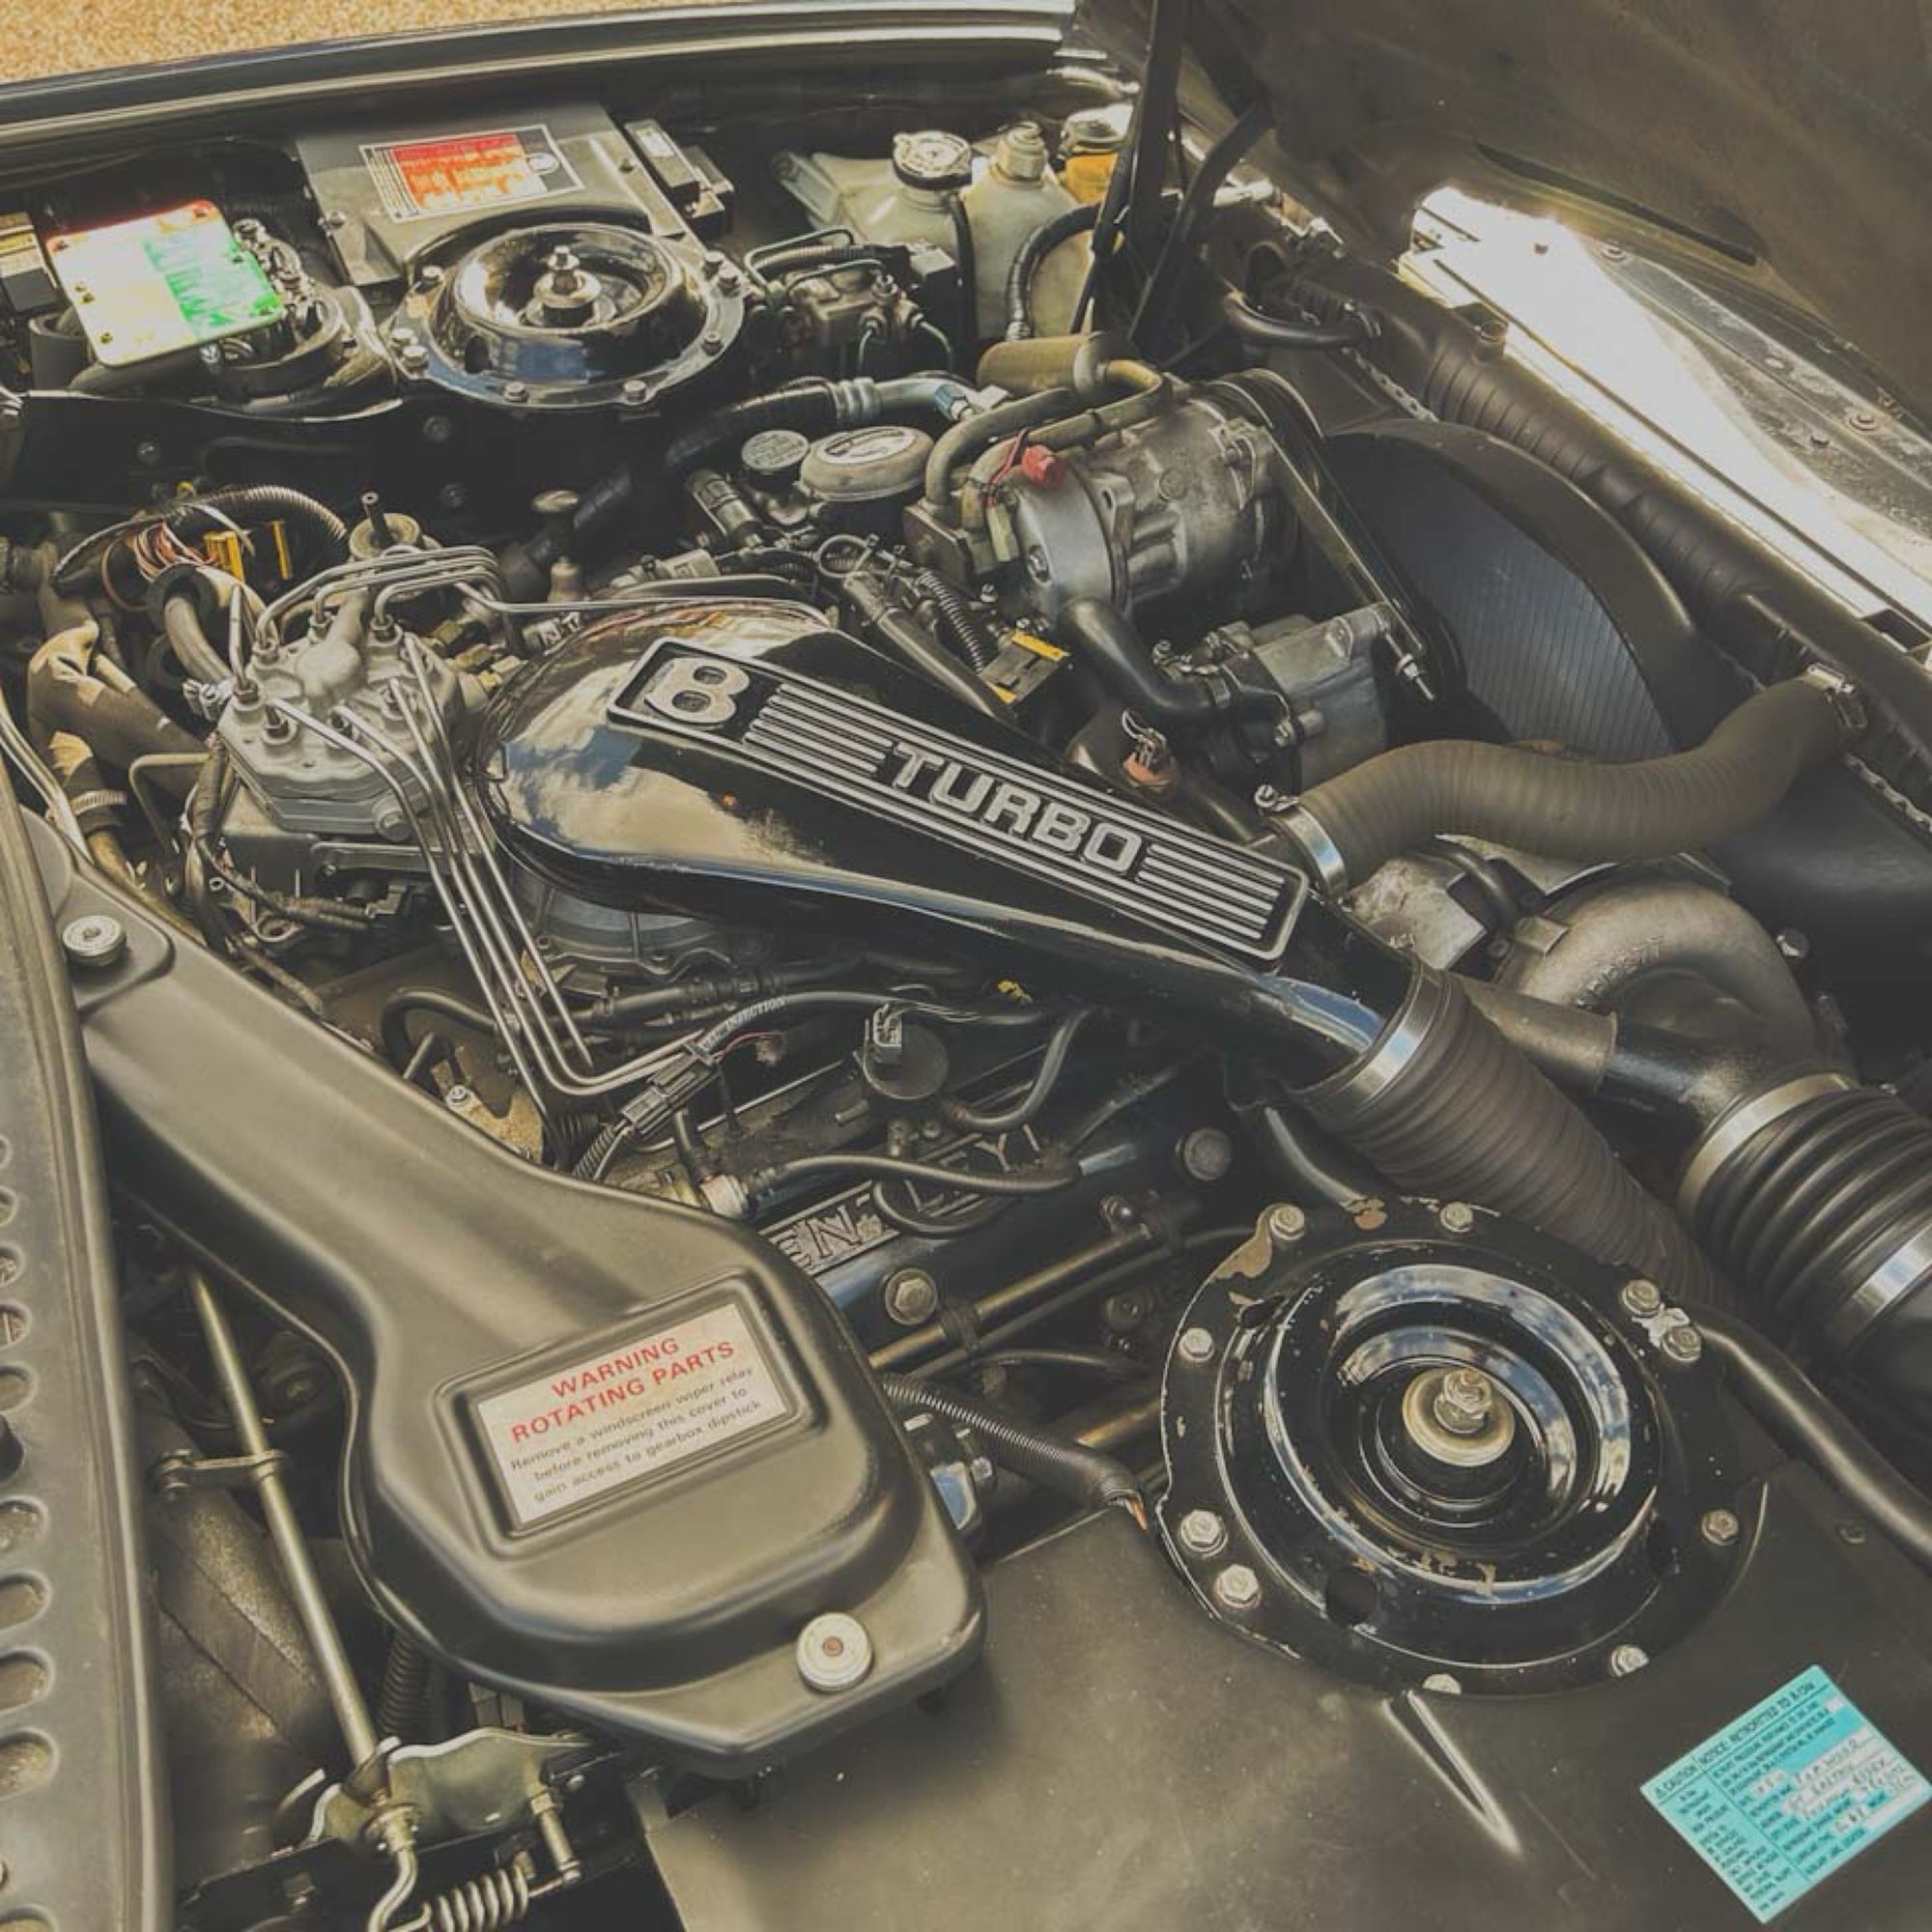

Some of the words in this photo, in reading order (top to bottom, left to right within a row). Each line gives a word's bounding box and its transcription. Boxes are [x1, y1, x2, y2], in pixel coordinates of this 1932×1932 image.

[643, 658, 751, 724] B
[893, 742, 1142, 871] TURBO
[511, 1378, 644, 1442] ROTATING
[652, 1342, 734, 1385] PARTS
[552, 1338, 679, 1398] WARNING
[511, 1442, 571, 1469] Remove
[577, 1435, 585, 1446] a
[589, 1402, 670, 1439] windscreen
[676, 1383, 714, 1403] wiper
[720, 1369, 753, 1385] relay
[534, 1457, 581, 1481] before
[587, 1429, 654, 1460] removing
[658, 1415, 685, 1430] this
[690, 1397, 725, 1417] cover
[732, 1388, 748, 1400] to
[534, 1483, 567, 1502] gain
[572, 1461, 620, 1486] access
[625, 1452, 641, 1463] to
[645, 1427, 702, 1457] gearbox
[708, 1400, 760, 1430] dipstick
